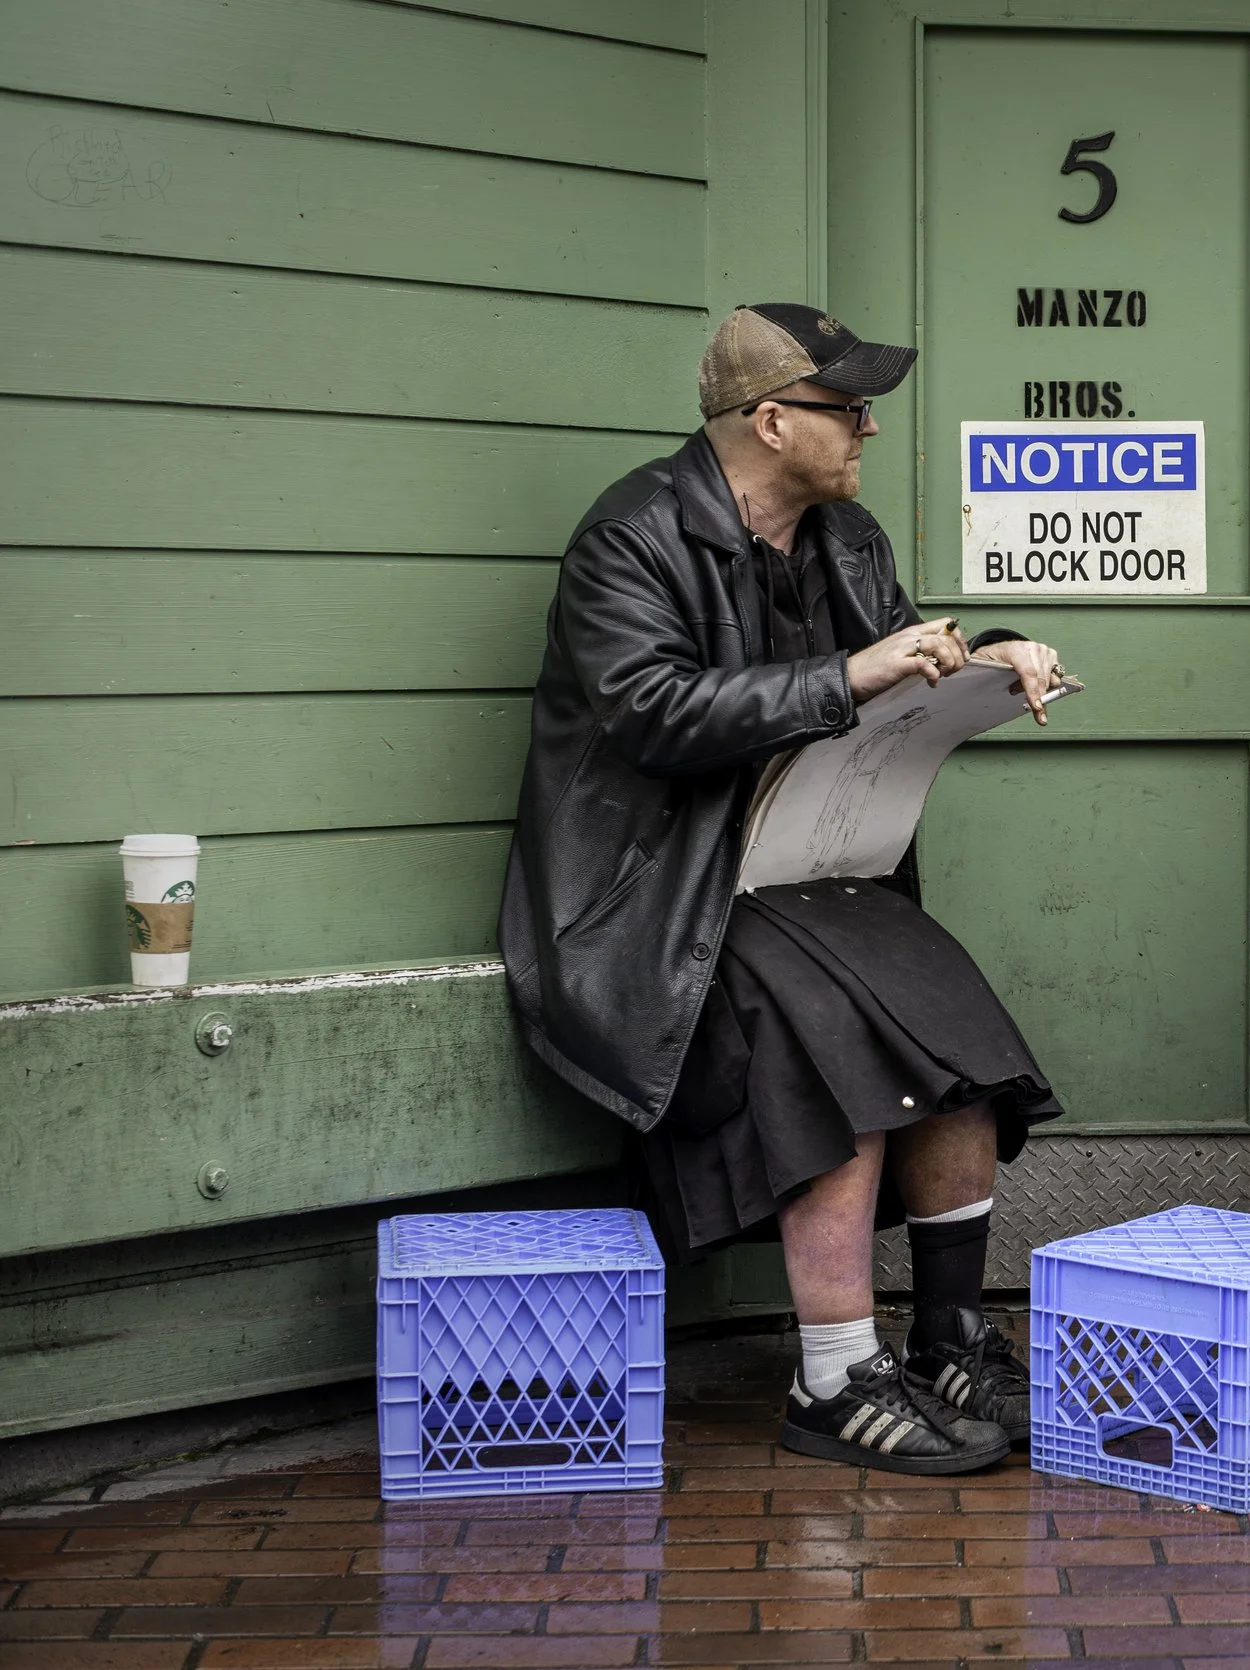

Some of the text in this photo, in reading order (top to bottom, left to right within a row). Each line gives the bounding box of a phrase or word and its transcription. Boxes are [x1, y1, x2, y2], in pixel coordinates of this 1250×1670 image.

[1057, 130, 1118, 225] 5
[1016, 288, 1147, 328] MANZO
[1024, 380, 1136, 419] BROS.
[982, 441, 1185, 485] NOTICE
[1029, 511, 1142, 545] DO NOT
[985, 548, 1187, 584] BLOCK DOOR
